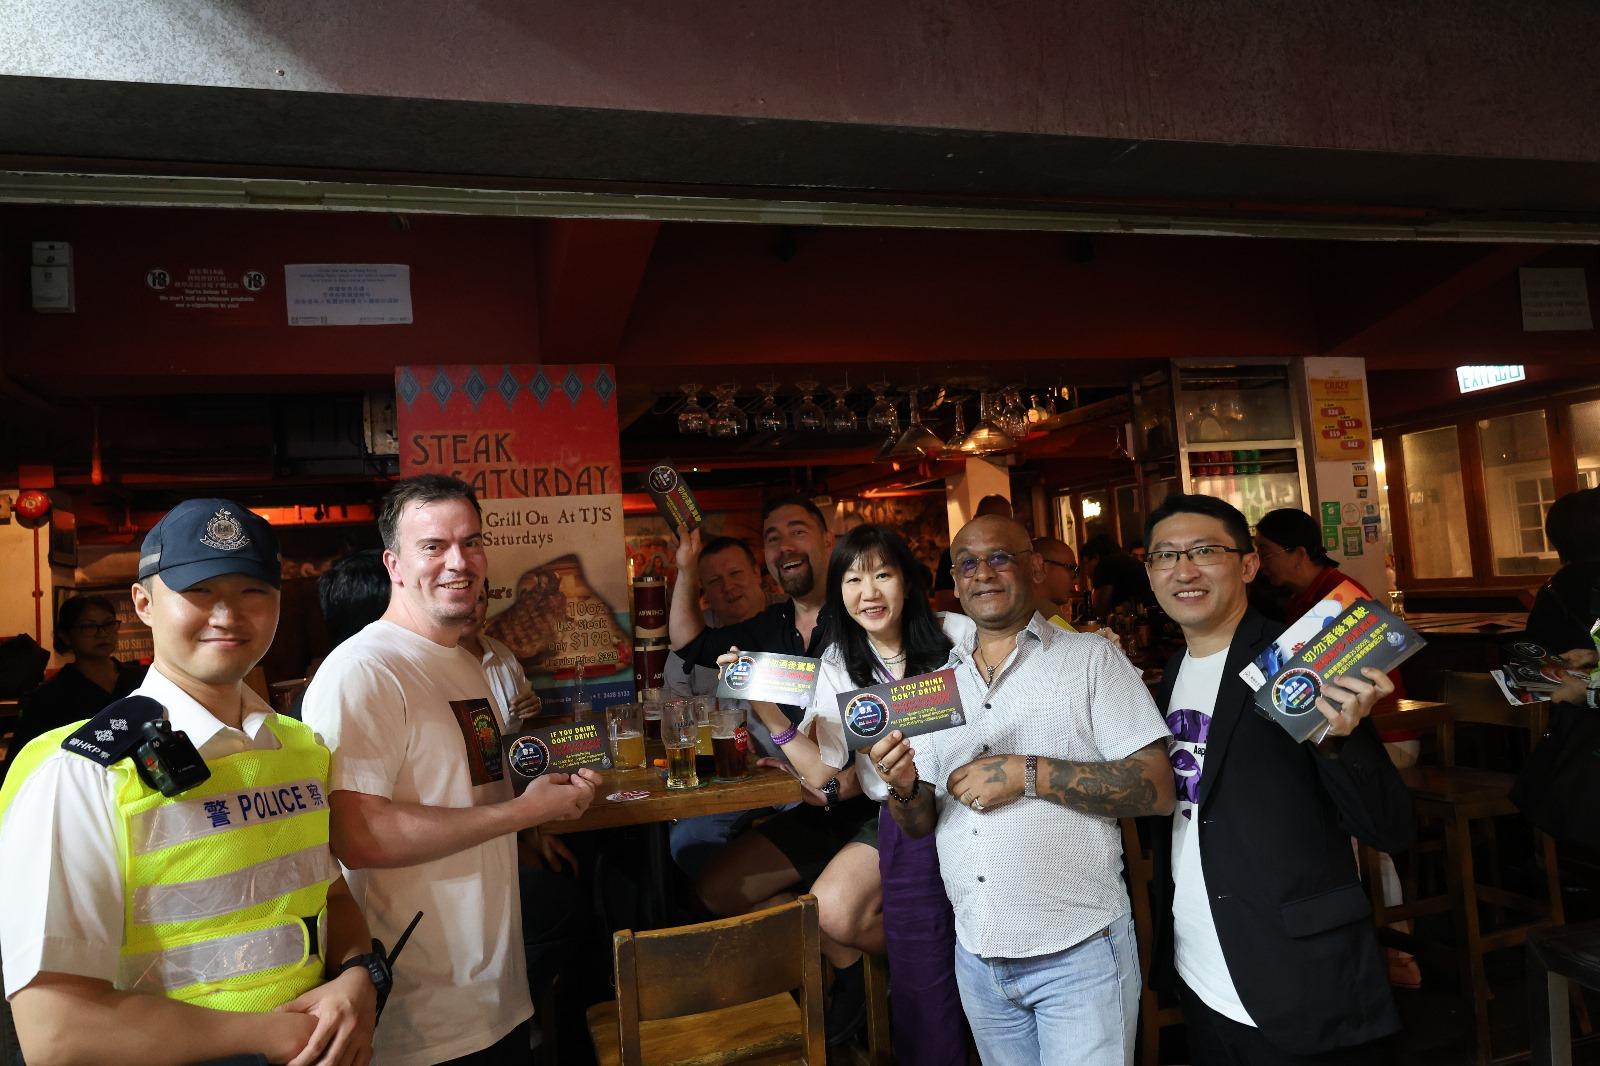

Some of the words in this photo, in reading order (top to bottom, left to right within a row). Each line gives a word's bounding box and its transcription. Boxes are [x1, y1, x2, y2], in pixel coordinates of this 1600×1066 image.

[411, 432, 512, 465] STEAK
[486, 510, 521, 528] Grill
[526, 510, 548, 526] On
[558, 508, 576, 524] At
[579, 506, 612, 525] TJ'S
[482, 531, 554, 549] Saturdays
[568, 602, 606, 616] 10oz
[578, 618, 607, 630] Steak
[570, 631, 611, 650] $198
[1302, 606, 1370, 663] 切勿酒後駕駛
[544, 656, 576, 667] Regular
[890, 686, 900, 695] IF
[901, 682, 917, 693] YOU
[919, 677, 944, 689] DRINK
[892, 692, 916, 702] DON'T
[918, 684, 946, 697] DRIVE!
[550, 730, 557, 739] IF
[558, 728, 573, 738] YOU
[574, 724, 596, 736] DRINK
[203, 800, 231, 828] 警
[238, 785, 308, 822] POLICE
[306, 783, 324, 807] 察
